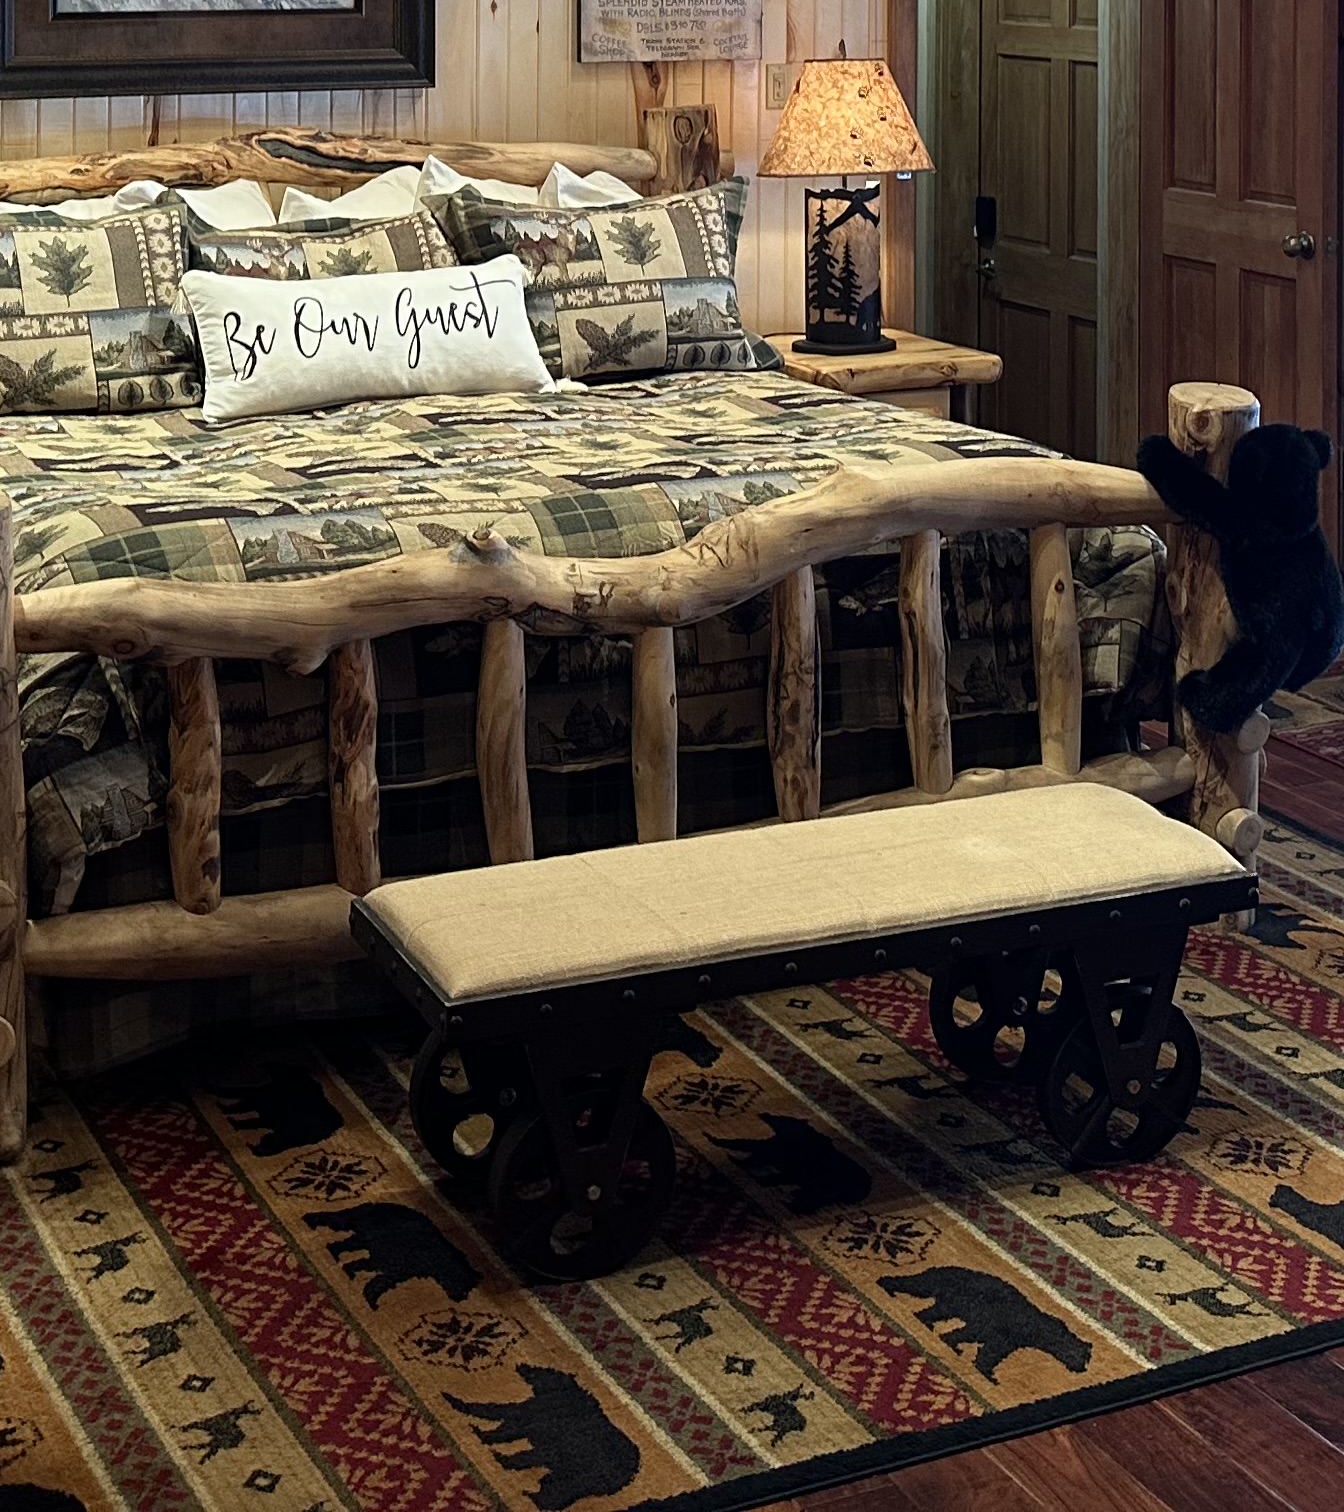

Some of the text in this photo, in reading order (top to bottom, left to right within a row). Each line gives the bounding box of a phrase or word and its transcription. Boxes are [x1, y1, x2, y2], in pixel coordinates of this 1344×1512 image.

[223, 271, 517, 381] Be Our Guest
